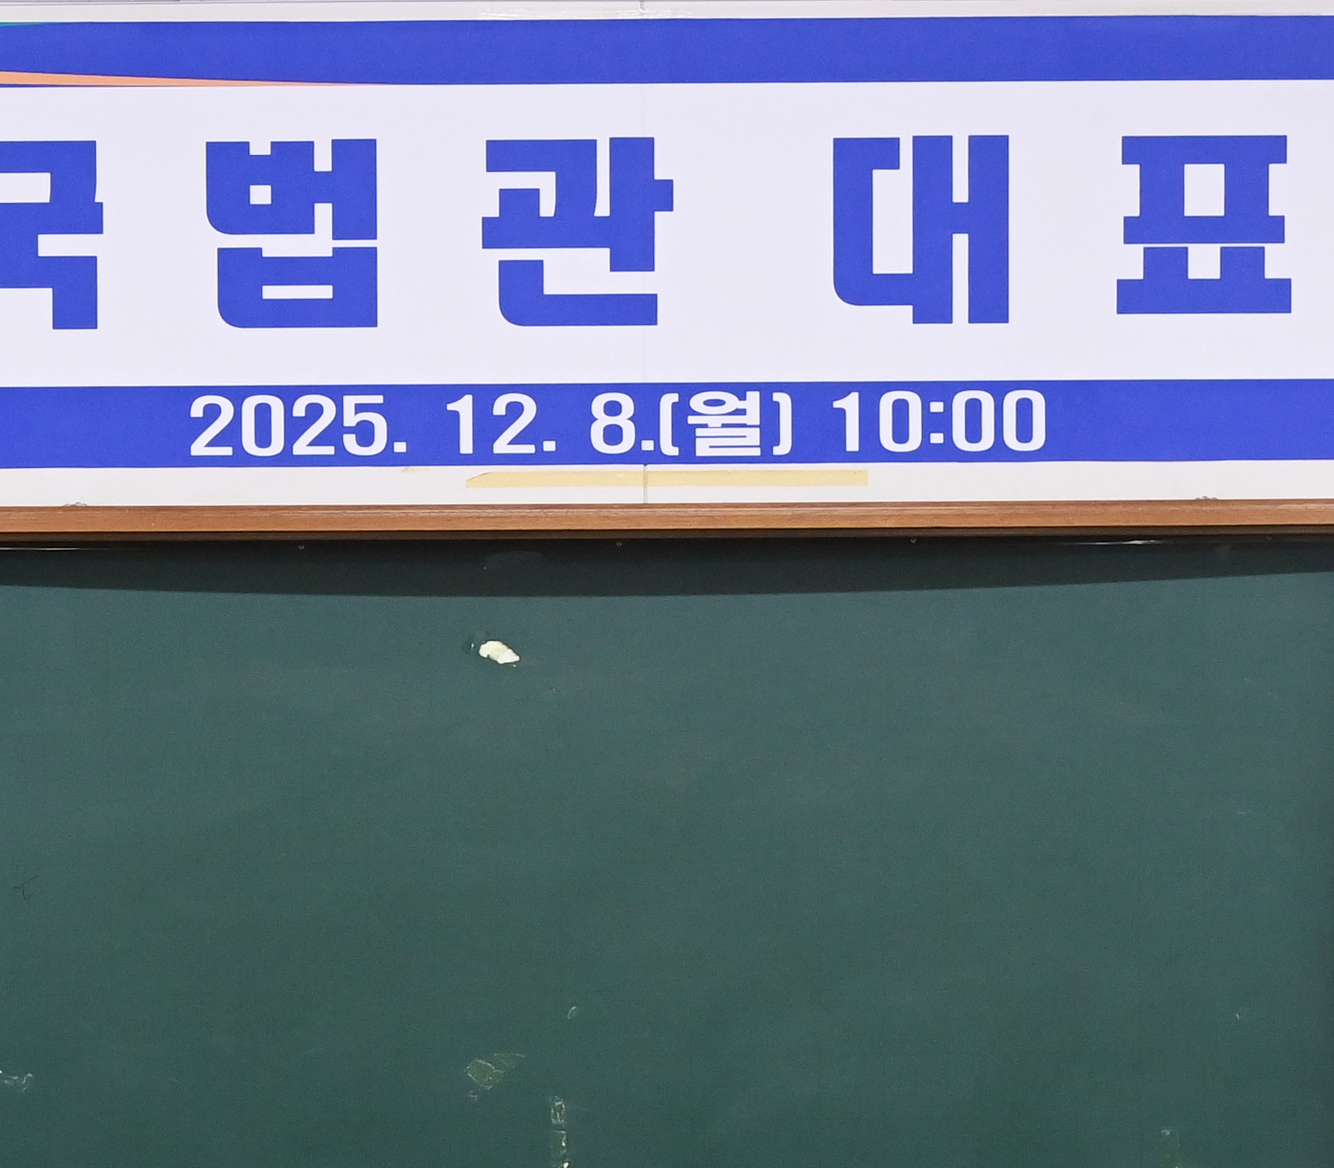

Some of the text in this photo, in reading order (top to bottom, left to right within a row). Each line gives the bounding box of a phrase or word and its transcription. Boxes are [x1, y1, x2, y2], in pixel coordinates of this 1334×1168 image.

[189, 393, 408, 457] 2025.
[445, 391, 557, 455] 12.
[830, 390, 1047, 453] 10:00
